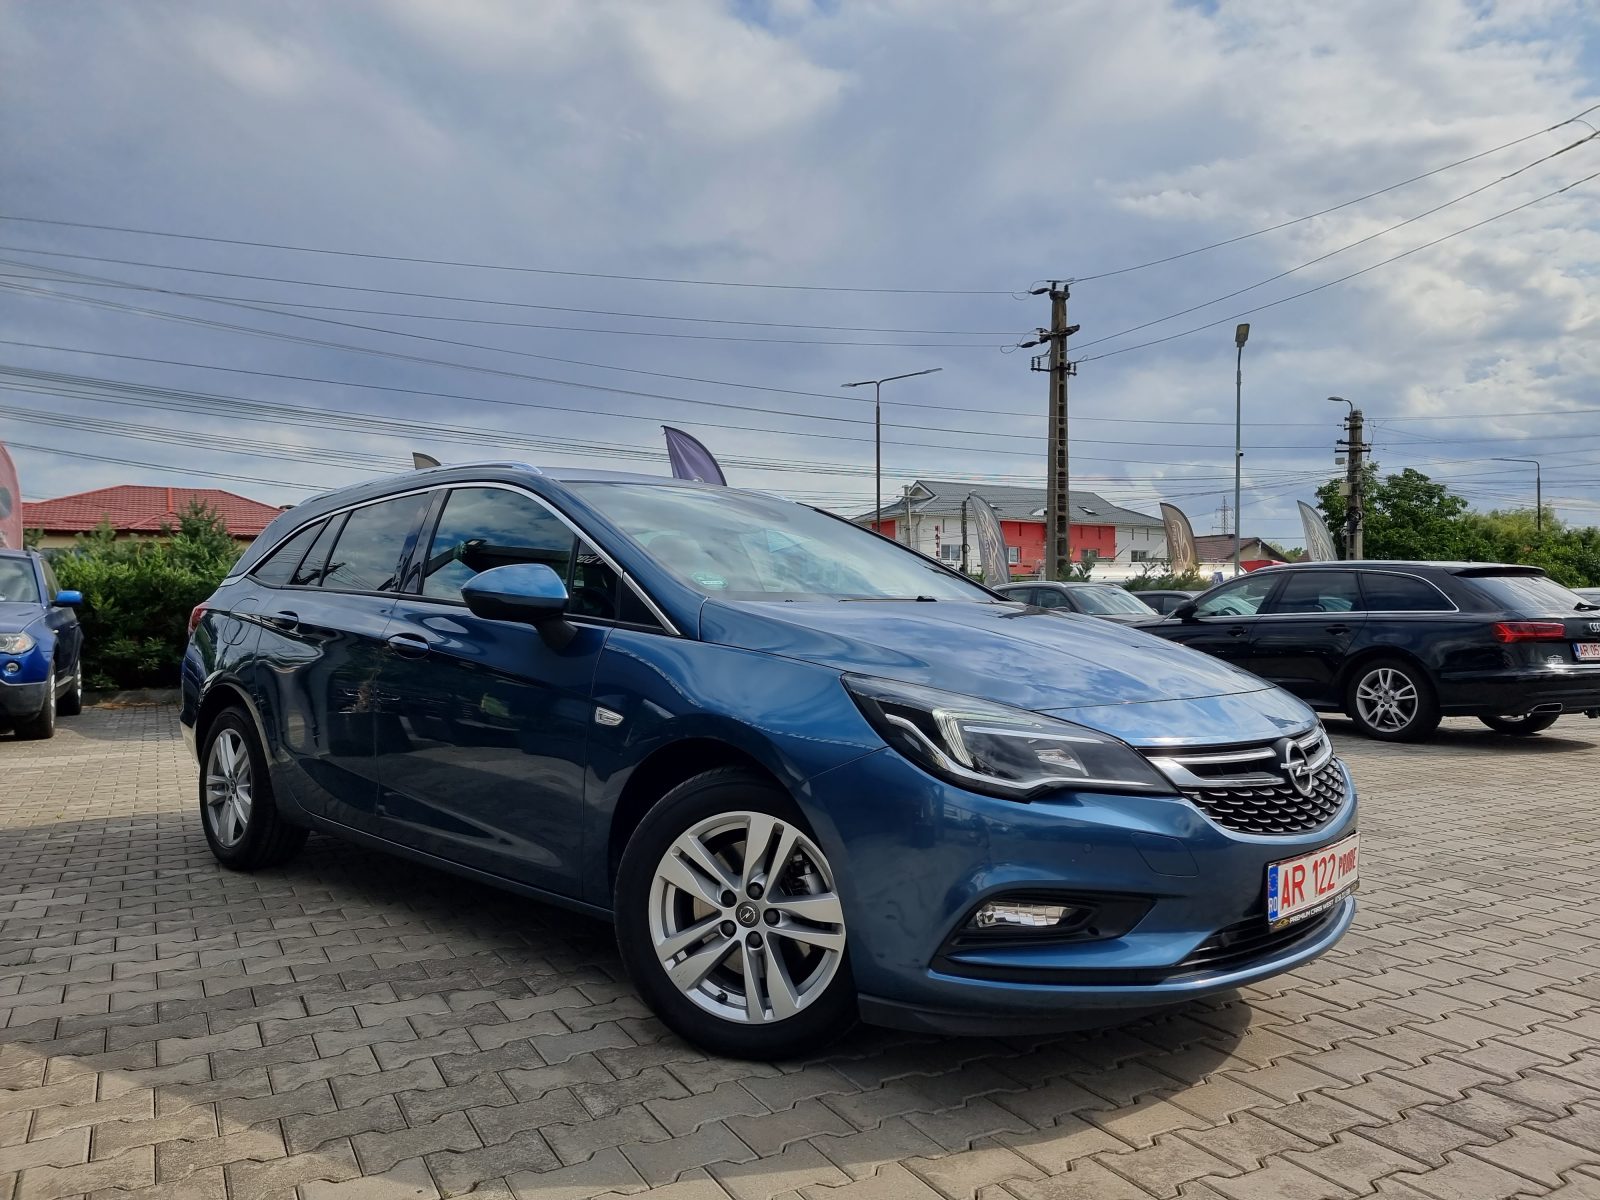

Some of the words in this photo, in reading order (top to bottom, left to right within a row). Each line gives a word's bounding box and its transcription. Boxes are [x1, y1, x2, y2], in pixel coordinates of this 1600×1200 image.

[1282, 864, 1306, 910] AR
[1312, 853, 1337, 897] 122
[1269, 896, 1278, 913] RO
